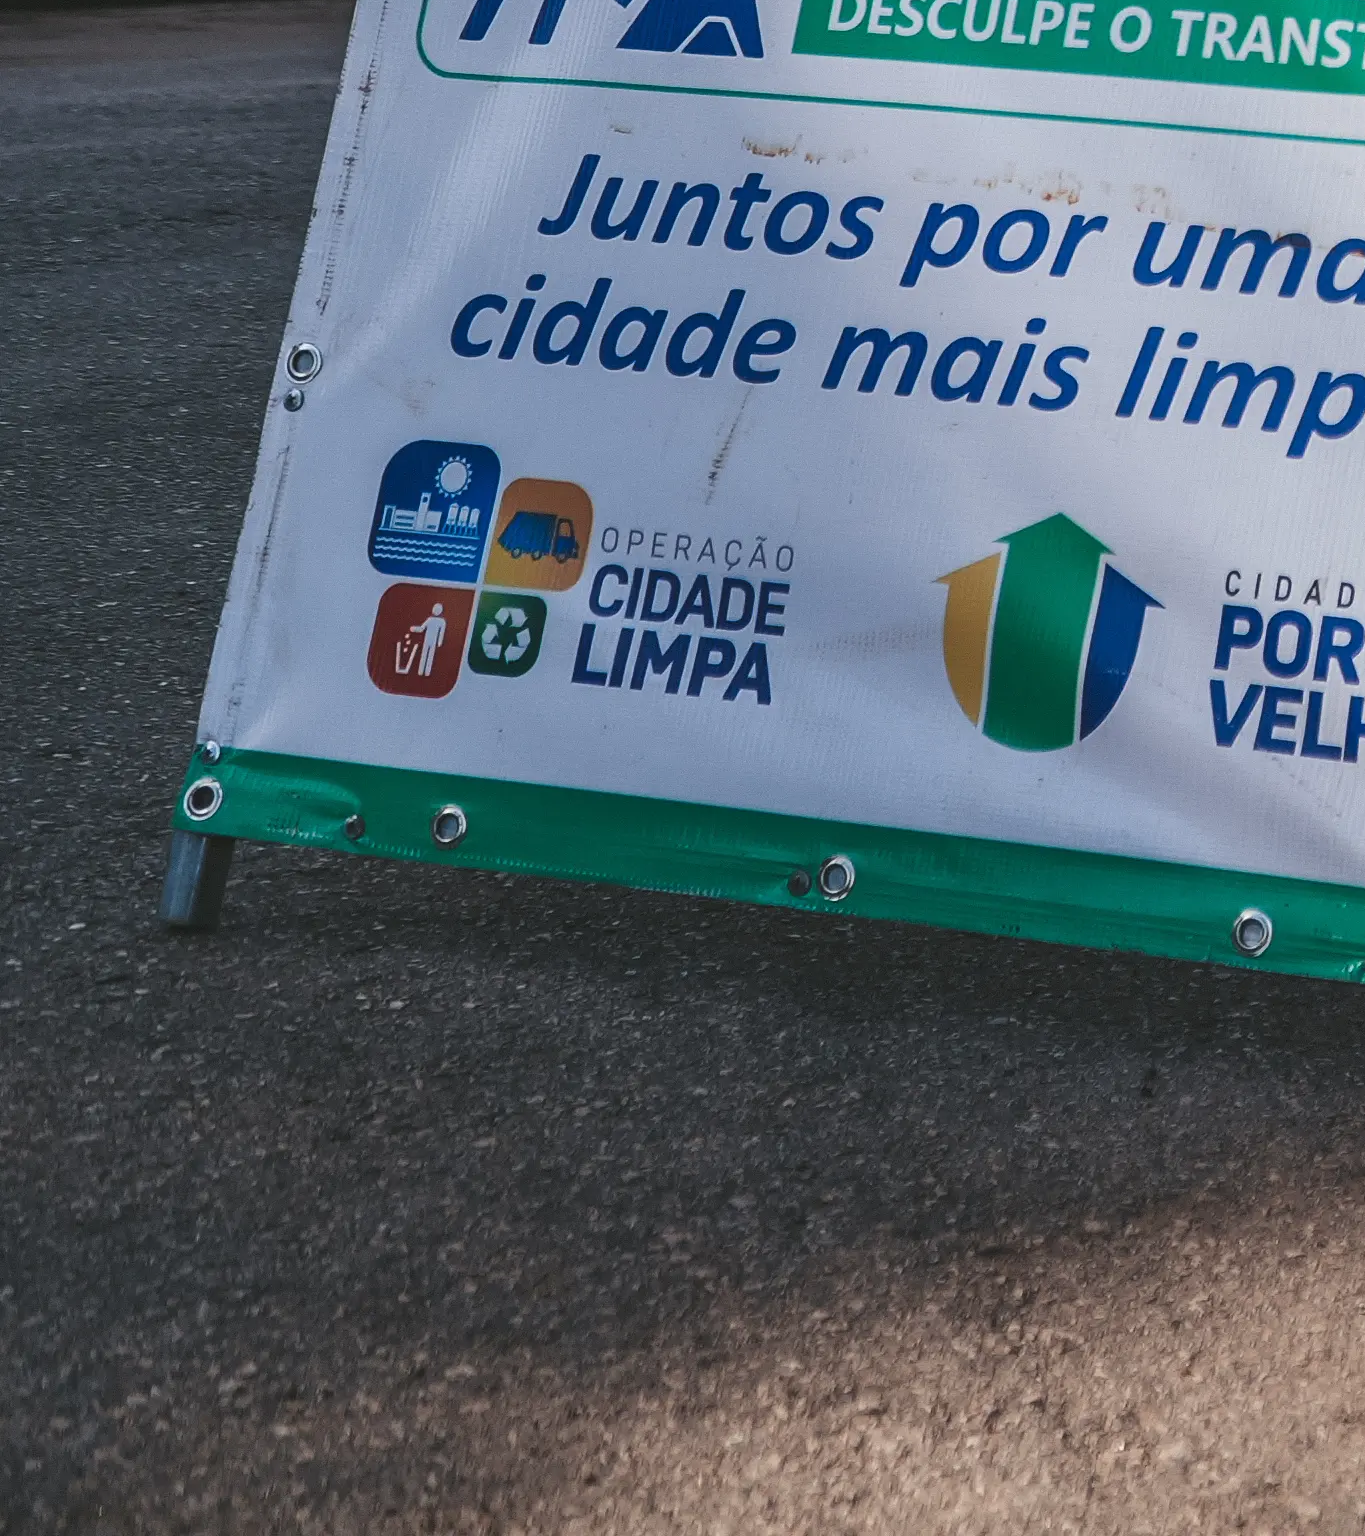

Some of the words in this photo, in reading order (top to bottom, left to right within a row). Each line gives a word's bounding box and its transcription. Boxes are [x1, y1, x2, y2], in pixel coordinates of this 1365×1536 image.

[1108, 5, 1153, 55] O
[536, 152, 885, 261] Juntos
[896, 201, 1109, 289] por
[448, 273, 798, 385] cidade
[820, 317, 1090, 413] mais
[600, 526, 796, 573] OPERAÇÃO
[588, 563, 791, 637] CIDADE
[570, 622, 772, 706] LIMPA
